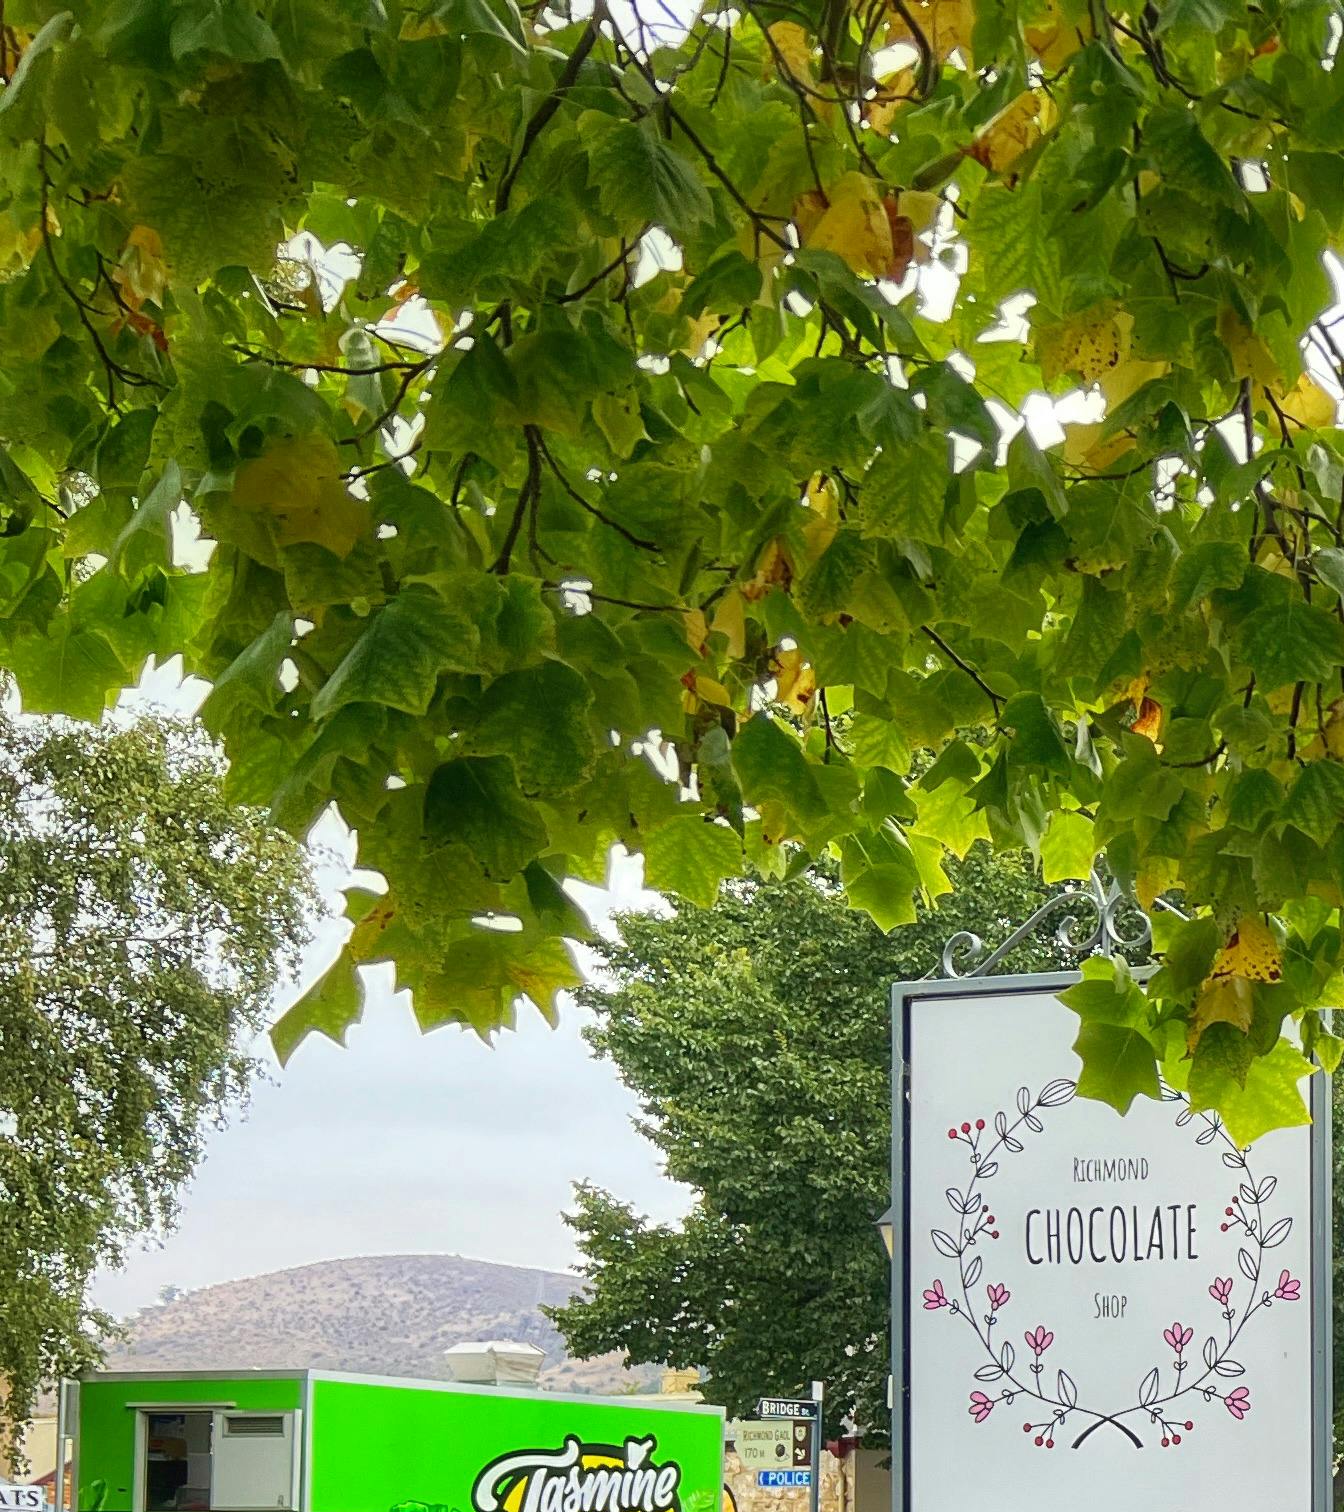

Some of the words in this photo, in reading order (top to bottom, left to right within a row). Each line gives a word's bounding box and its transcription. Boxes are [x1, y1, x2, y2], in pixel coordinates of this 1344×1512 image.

[1073, 1156, 1149, 1183] RICHMOND
[1025, 1203, 1200, 1265] CHOCOLATE
[1093, 1292, 1127, 1320] SHOP
[762, 1400, 800, 1416] BRIDGE
[745, 1448, 758, 1458] 170
[768, 1471, 810, 1485] POLICE
